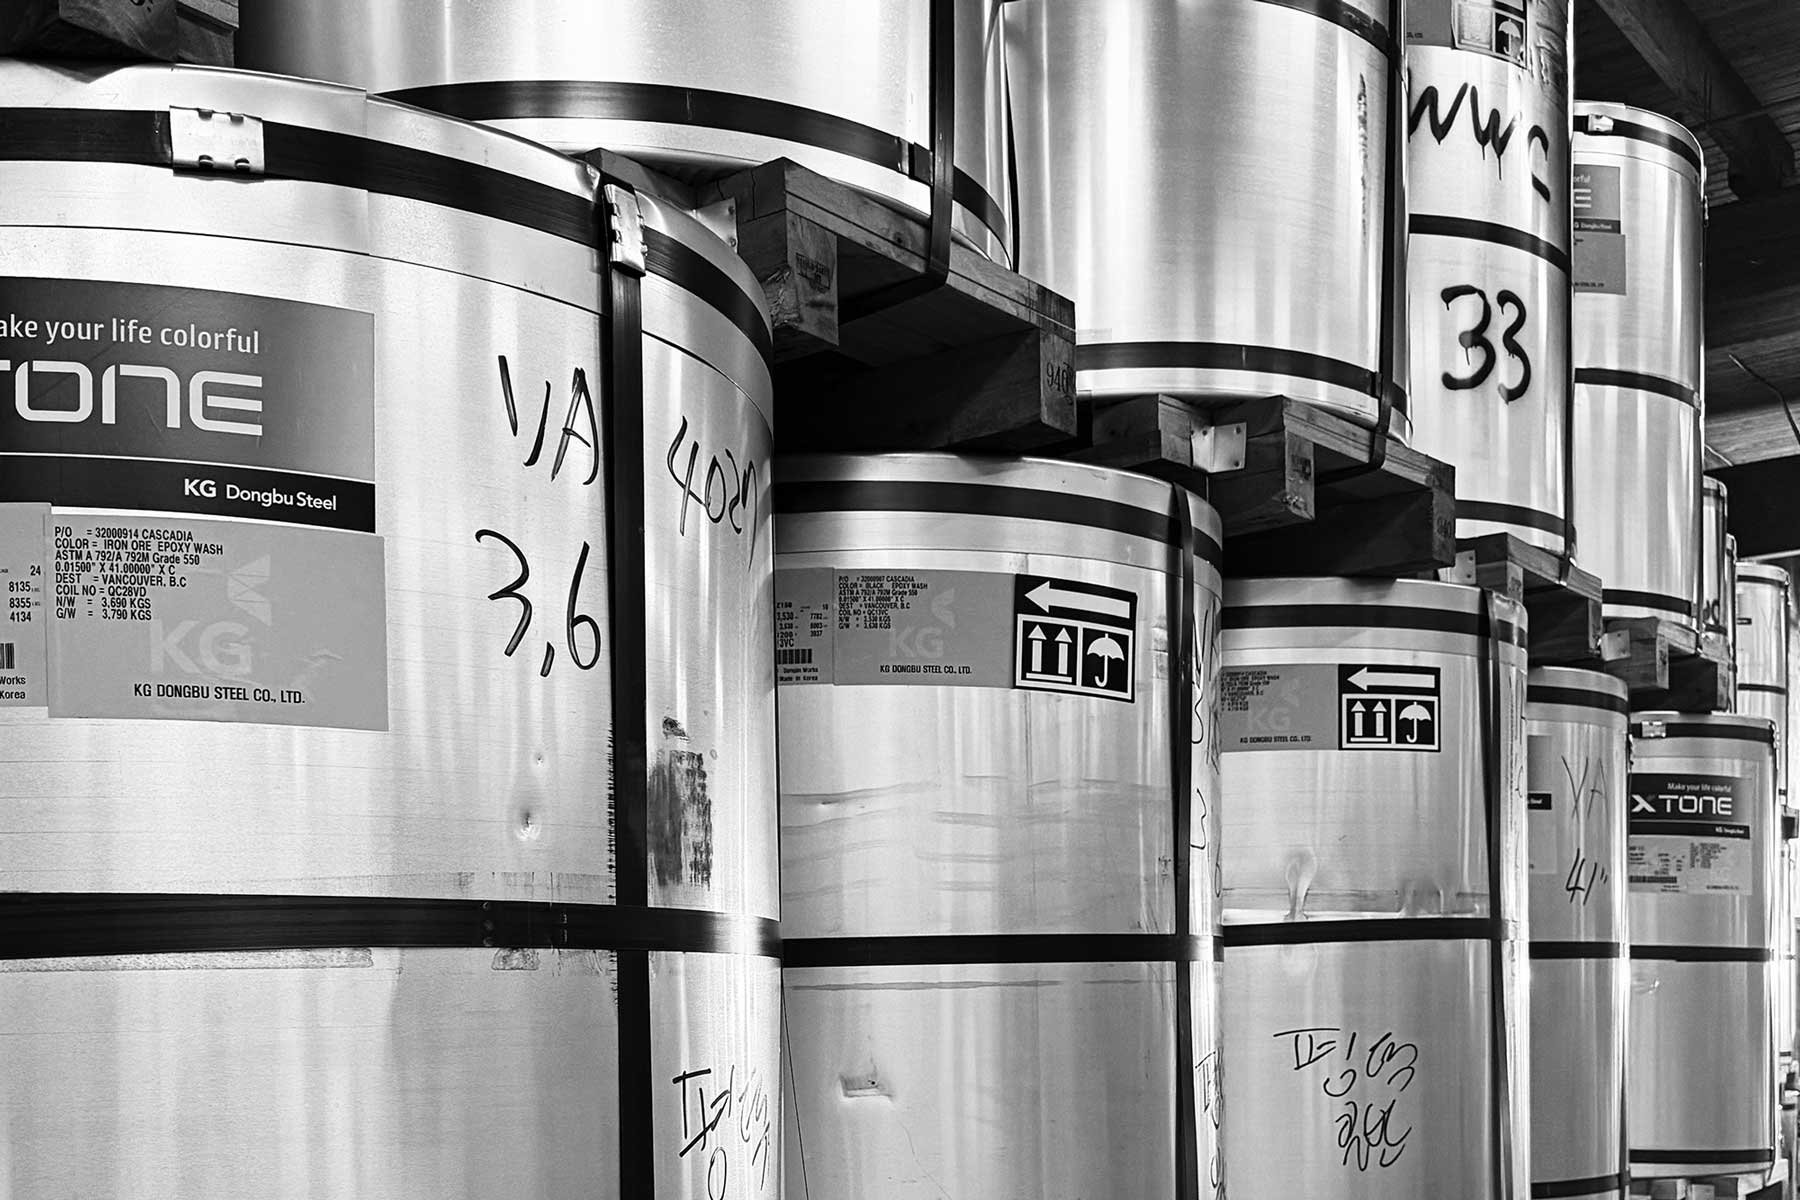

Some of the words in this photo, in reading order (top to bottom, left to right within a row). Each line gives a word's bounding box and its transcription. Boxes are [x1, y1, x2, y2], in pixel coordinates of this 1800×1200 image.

[46, 321, 104, 344] your
[112, 318, 152, 343] life
[160, 324, 259, 354] colorful
[1440, 285, 1532, 404] 33
[0, 359, 263, 436] ONE
[184, 478, 217, 498] KG
[226, 484, 293, 506] Dongbu
[297, 491, 337, 511] Steel
[55, 526, 72, 537] P/O
[95, 527, 139, 539] 32000914
[142, 529, 193, 542] CASCADIA
[55, 538, 89, 549] COLOR
[104, 539, 128, 550] IRON
[131, 540, 151, 551] ORE
[158, 541, 191, 553] EPOXY
[194, 543, 223, 555] WASH
[55, 550, 83, 561] ASTM
[86, 550, 92, 561] A
[96, 551, 122, 562] 792/A
[125, 552, 149, 562] 792M
[152, 553, 180, 564] Grade
[183, 554, 200, 565] 550
[30, 565, 41, 576] 24
[55, 561, 96, 573] 0.01500"
[100, 562, 105, 573] X
[109, 563, 155, 574] 41.00000"
[159, 564, 165, 575] X
[168, 565, 176, 575] C
[9, 581, 31, 593] 8135
[55, 573, 81, 584] DEST
[169, 577, 187, 588] B.C
[56, 584, 79, 595] COIL
[82, 584, 96, 596] NO
[108, 586, 146, 597] QC28VD
[9, 597, 31, 609] 8355
[56, 596, 75, 607] N/W
[129, 598, 151, 610] KGS
[9, 611, 32, 622] 4134
[56, 608, 76, 619] G/W
[130, 609, 152, 621] KGS
[150, 618, 251, 674] KG
[880, 664, 891, 673] KG
[892, 665, 922, 674] DONGBU
[922, 665, 942, 674] STEEL
[0, 690, 26, 700] Korea
[134, 683, 152, 697] KG
[157, 684, 210, 699] DONGBU
[214, 686, 249, 701] STEEL
[280, 690, 305, 704] LTD.
